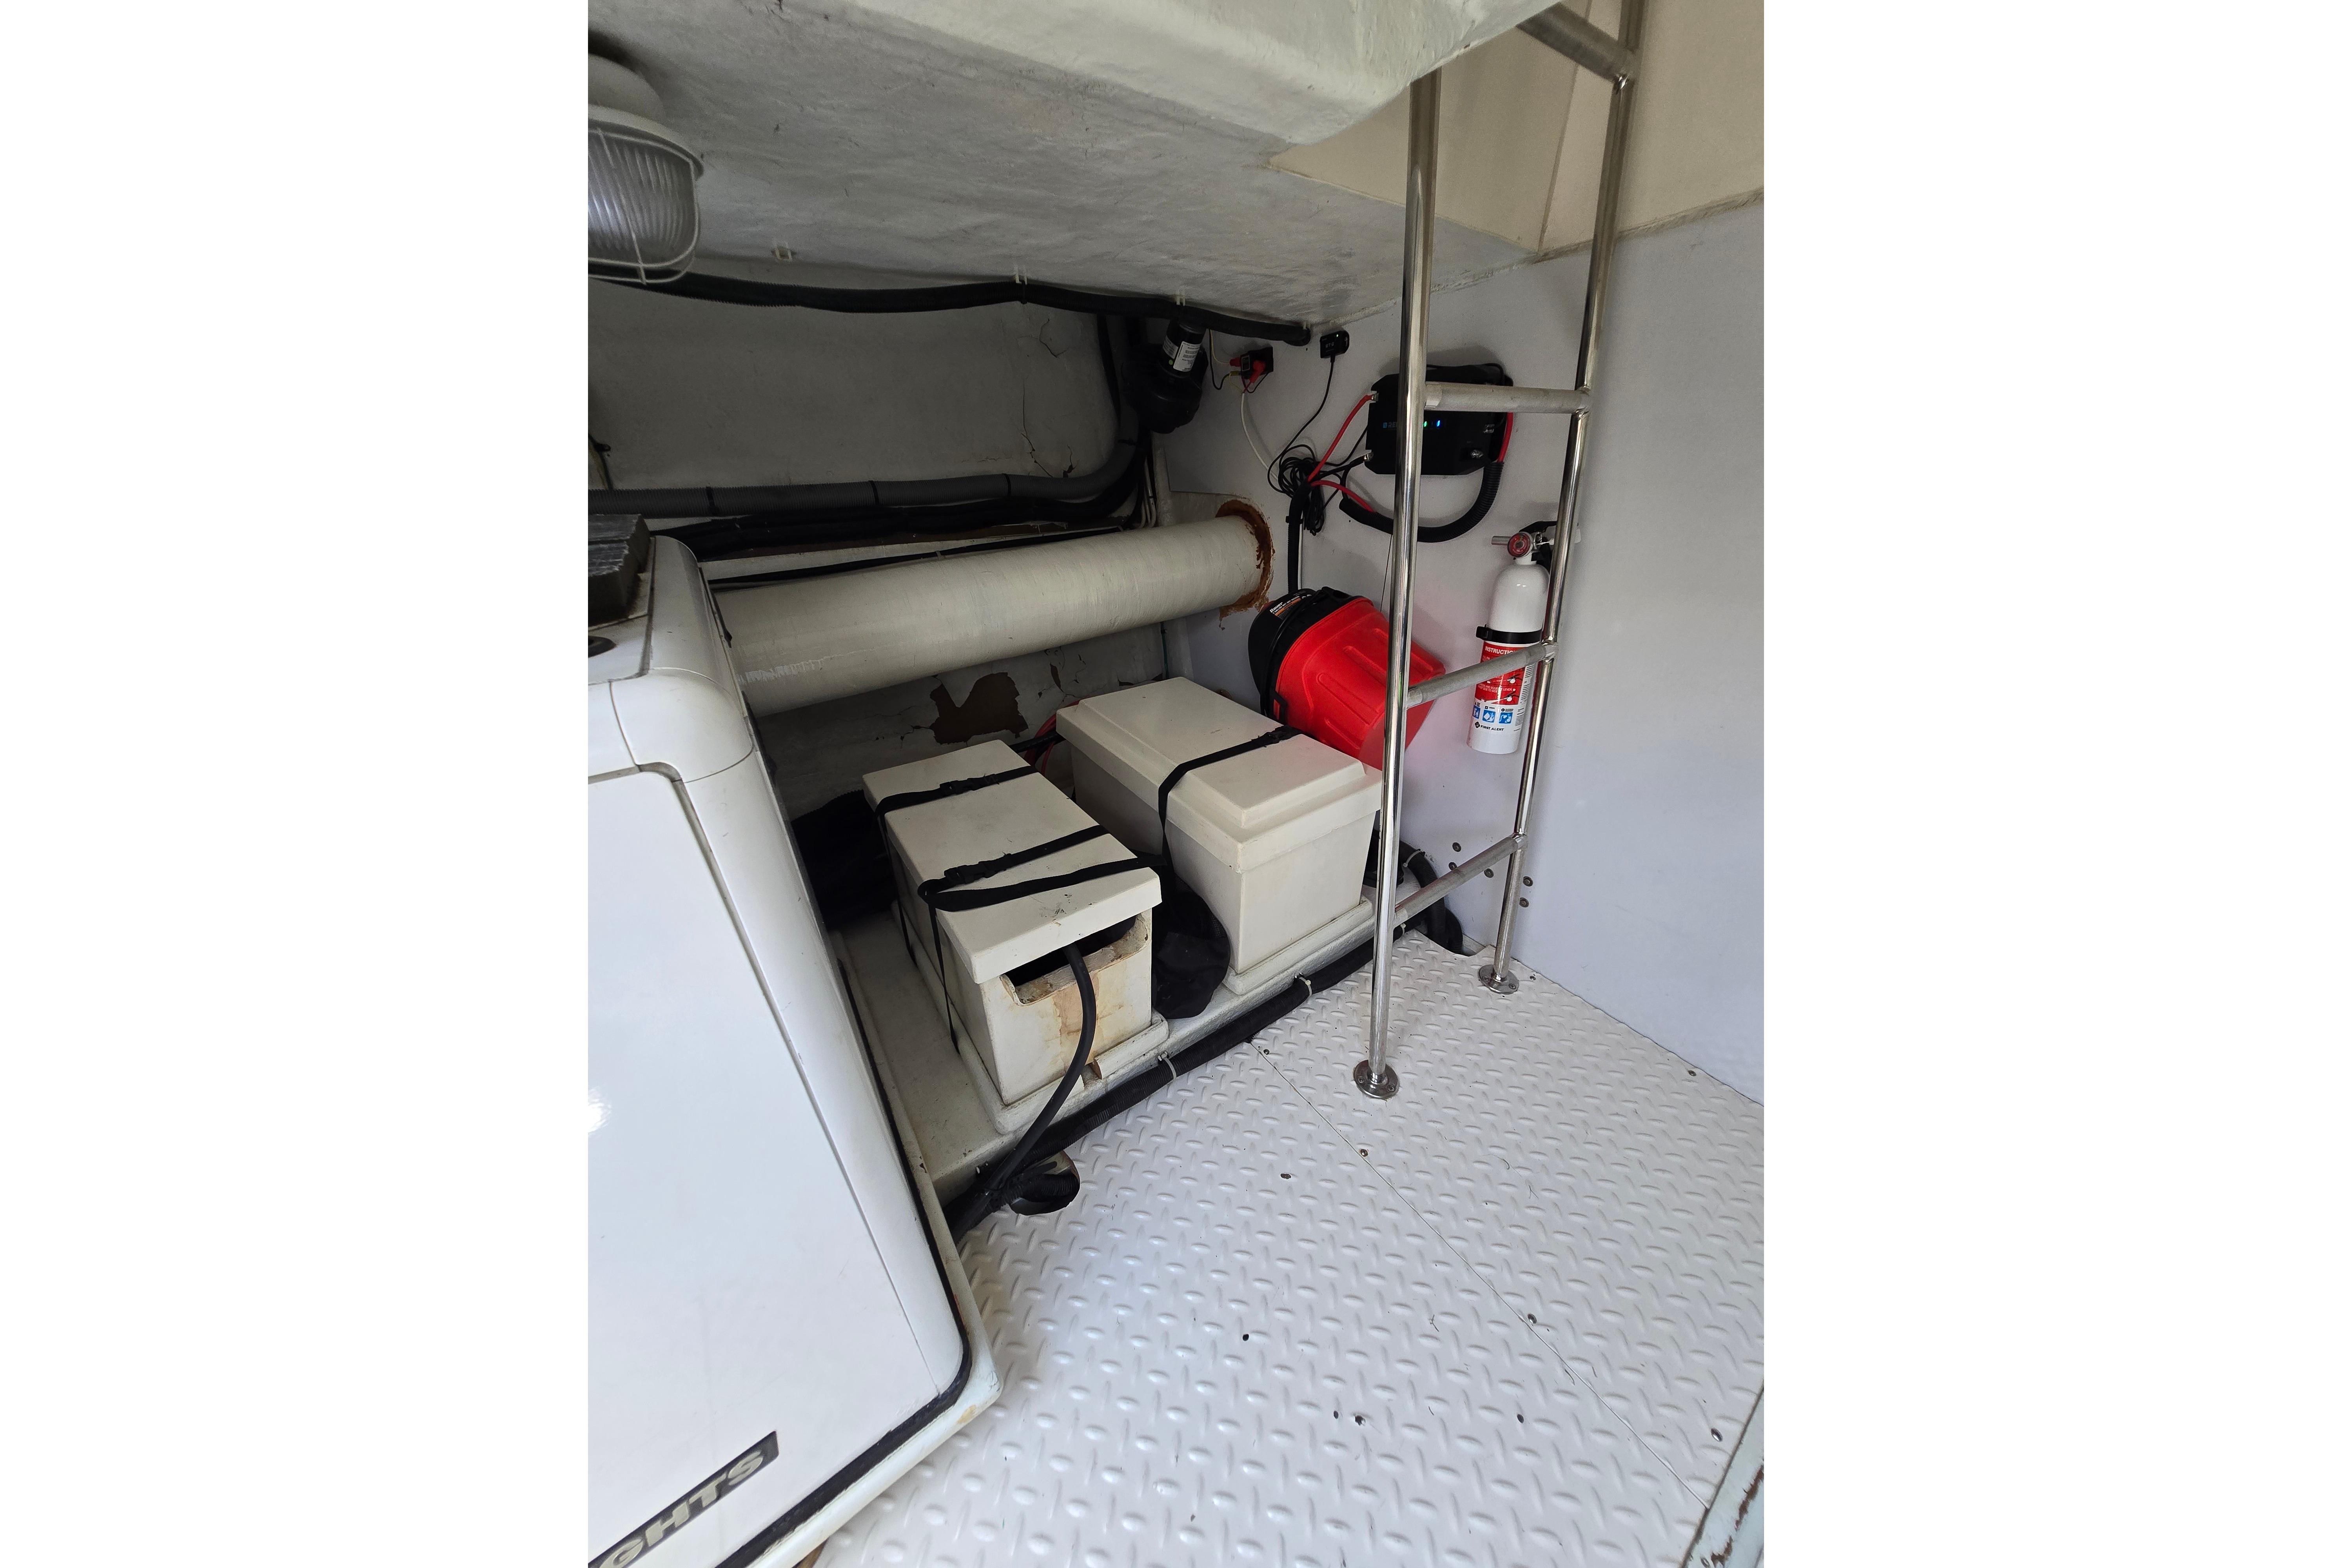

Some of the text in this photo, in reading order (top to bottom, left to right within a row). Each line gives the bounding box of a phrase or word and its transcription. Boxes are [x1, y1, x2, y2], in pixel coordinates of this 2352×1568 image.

[1270, 602, 1283, 613] Bauer
[1485, 646, 1515, 655] INSTRUCTIO
[599, 1450, 764, 1568] GHTS
